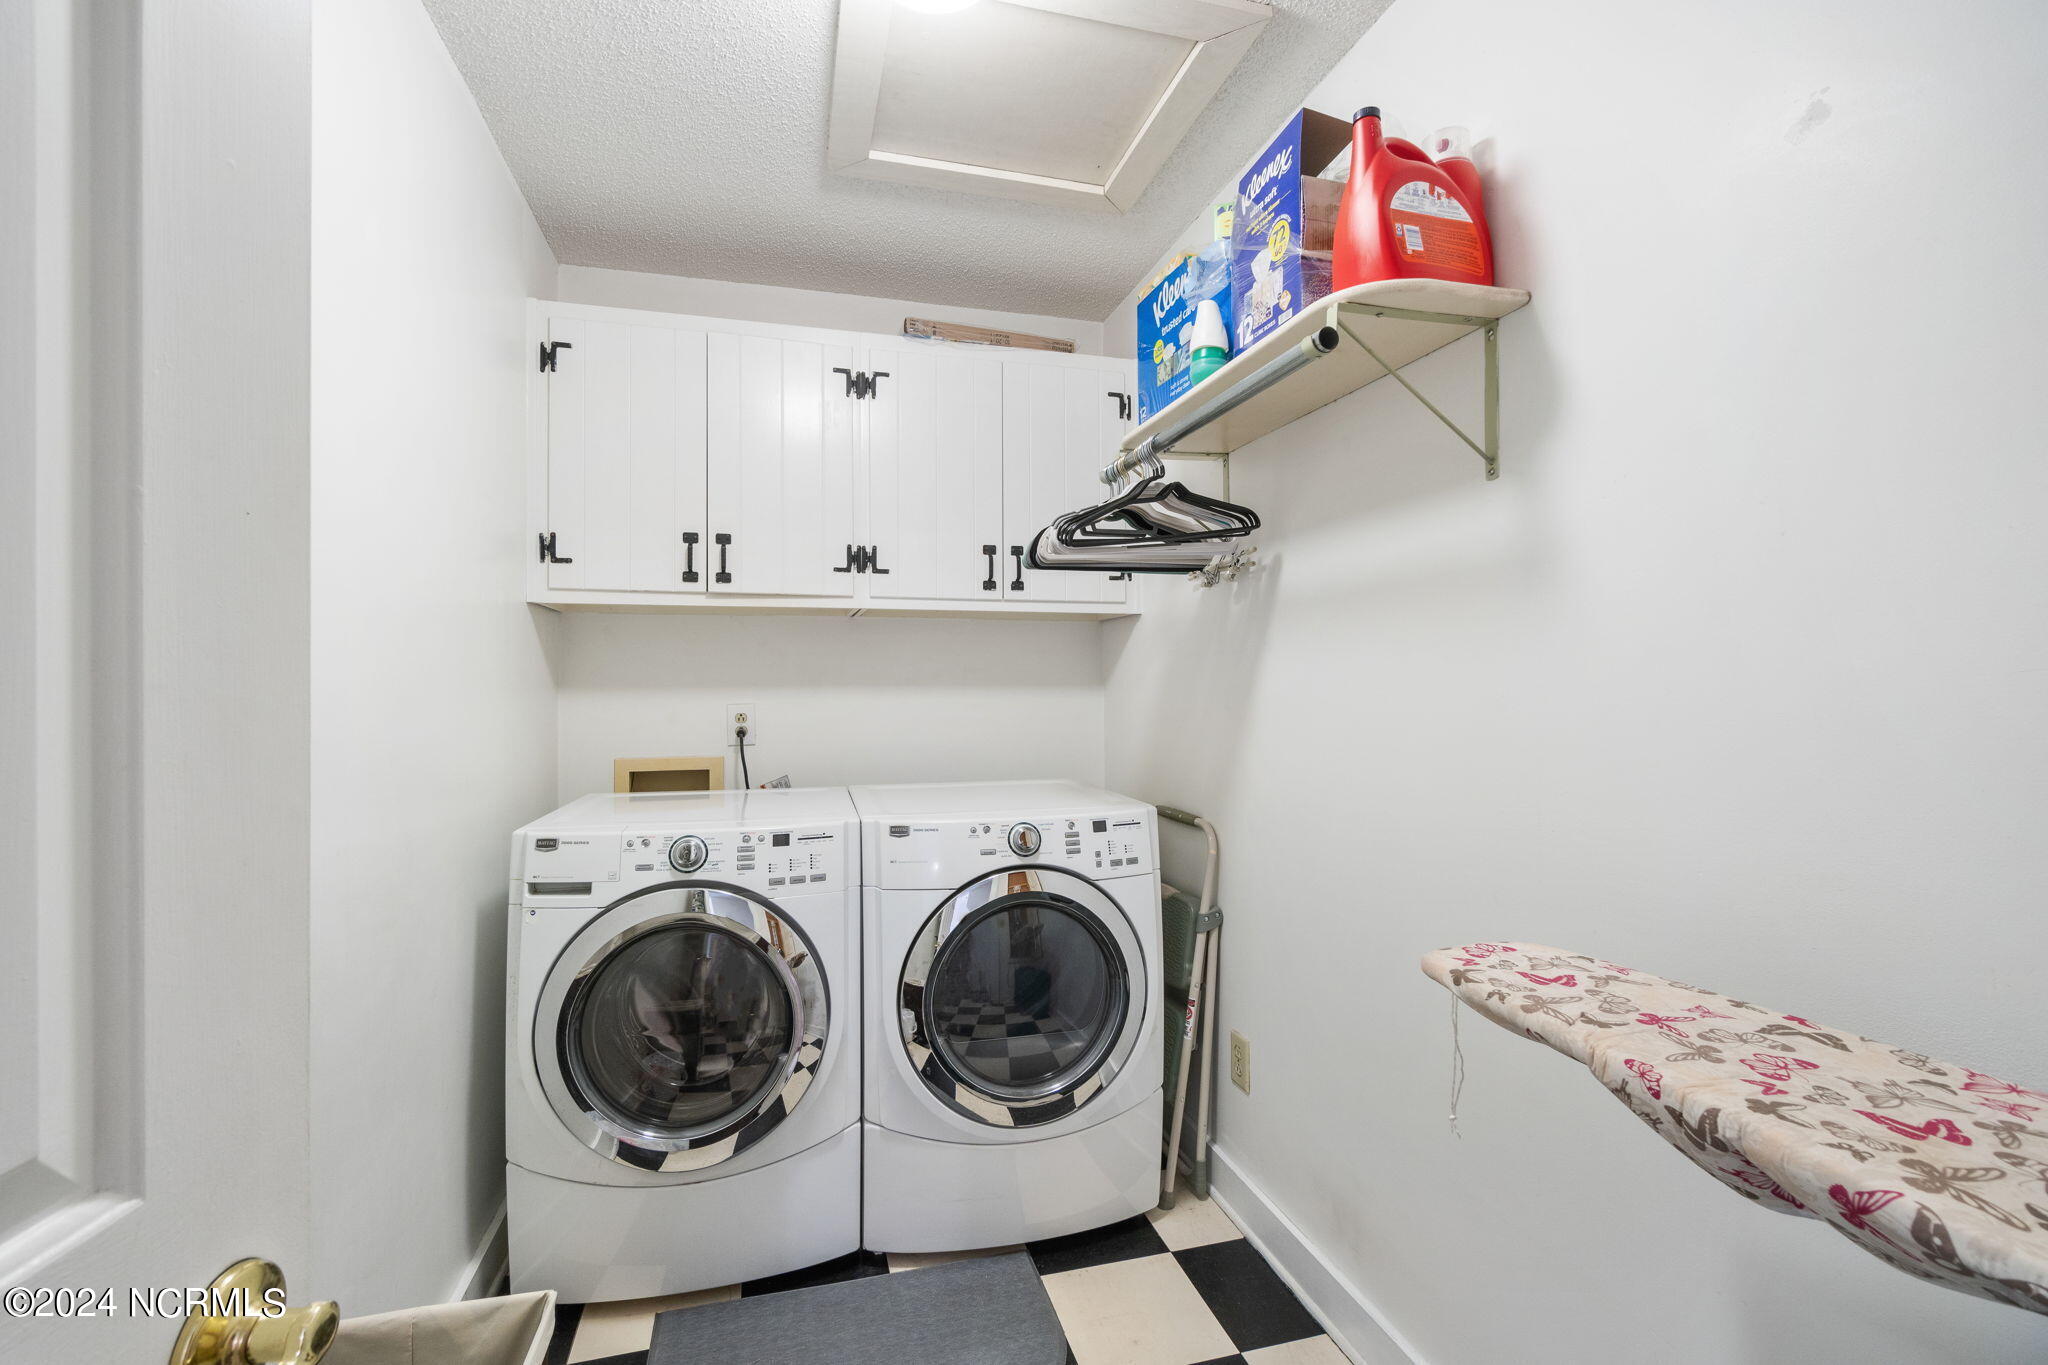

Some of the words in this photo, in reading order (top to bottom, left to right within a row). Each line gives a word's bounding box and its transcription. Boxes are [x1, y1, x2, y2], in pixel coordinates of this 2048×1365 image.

[1242, 145, 1292, 215] Kleenex
[1264, 186, 1278, 205] soft
[1273, 225, 1286, 248] 72
[1153, 273, 1189, 328] Kleen
[1237, 313, 1254, 348] 12
